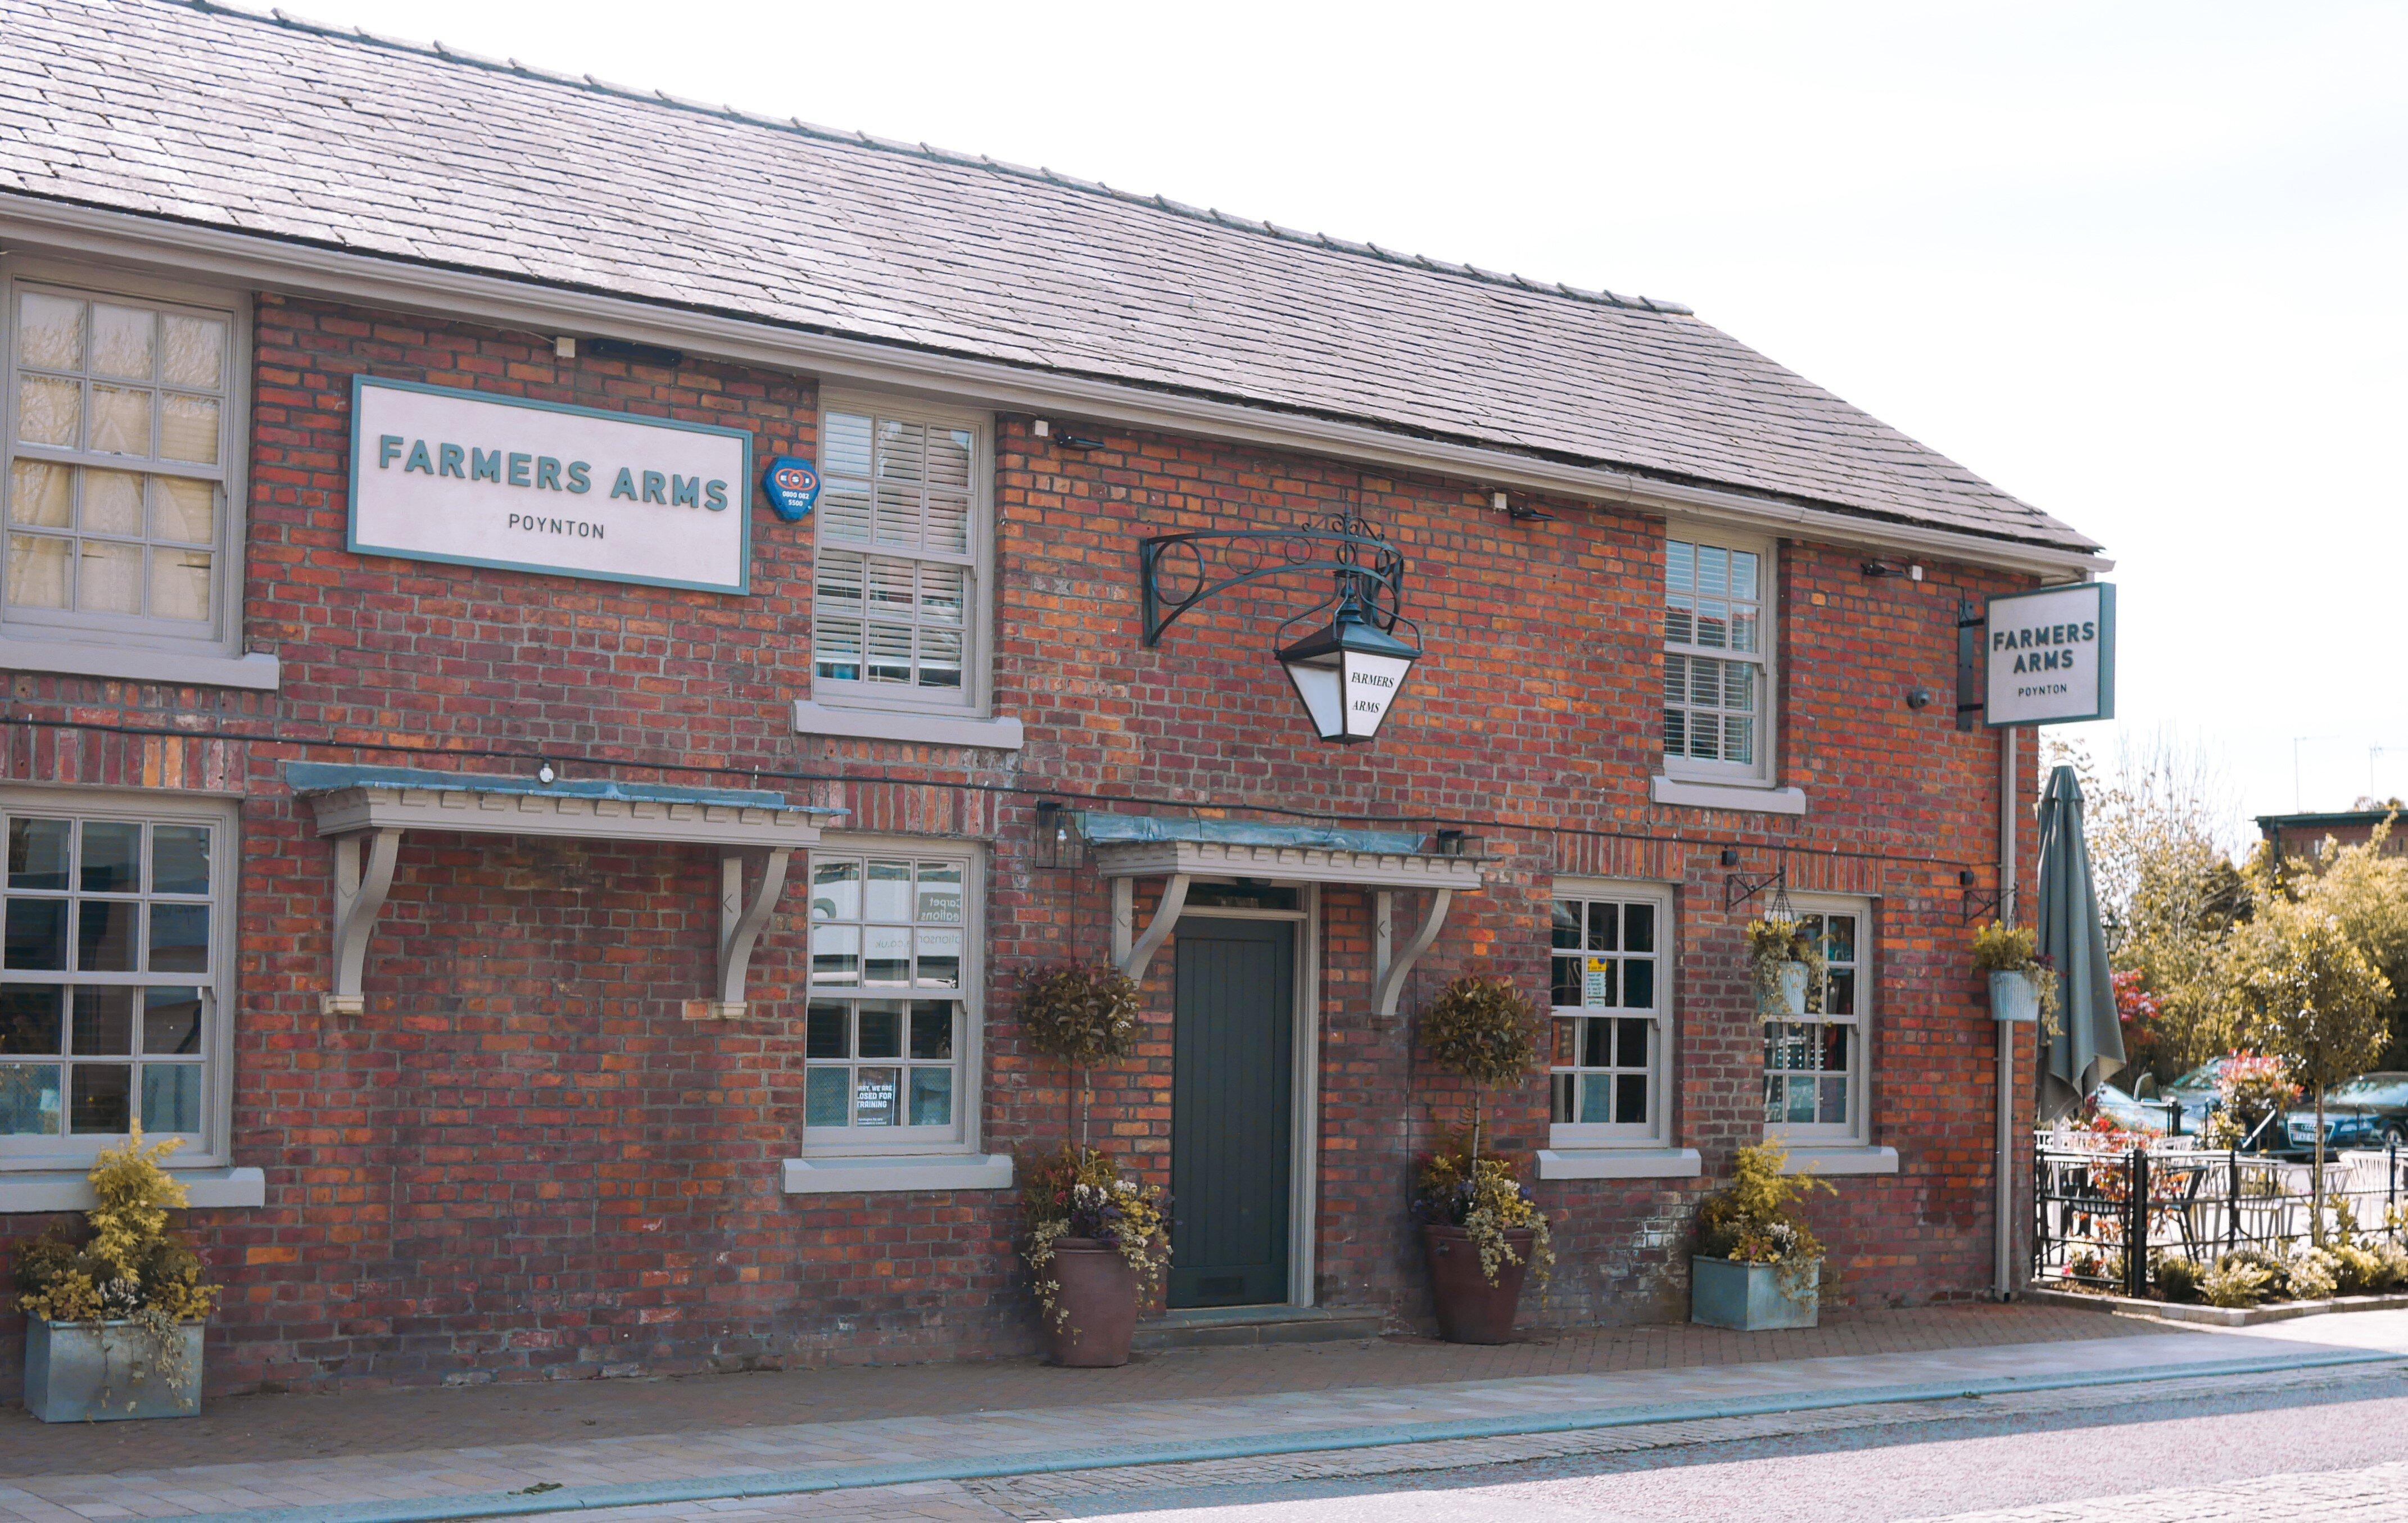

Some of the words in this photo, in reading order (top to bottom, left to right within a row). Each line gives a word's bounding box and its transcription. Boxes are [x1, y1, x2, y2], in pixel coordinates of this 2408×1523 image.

[380, 434, 591, 493] FARMERS
[610, 467, 728, 511] ARMS
[509, 513, 604, 539] POYNTON
[1993, 622, 2095, 651] FARMERS
[2013, 649, 2074, 674] ARMS
[1351, 672, 1395, 688] FARMERS
[2018, 683, 2067, 697] POYNTON
[1352, 700, 1380, 713] ARMS
